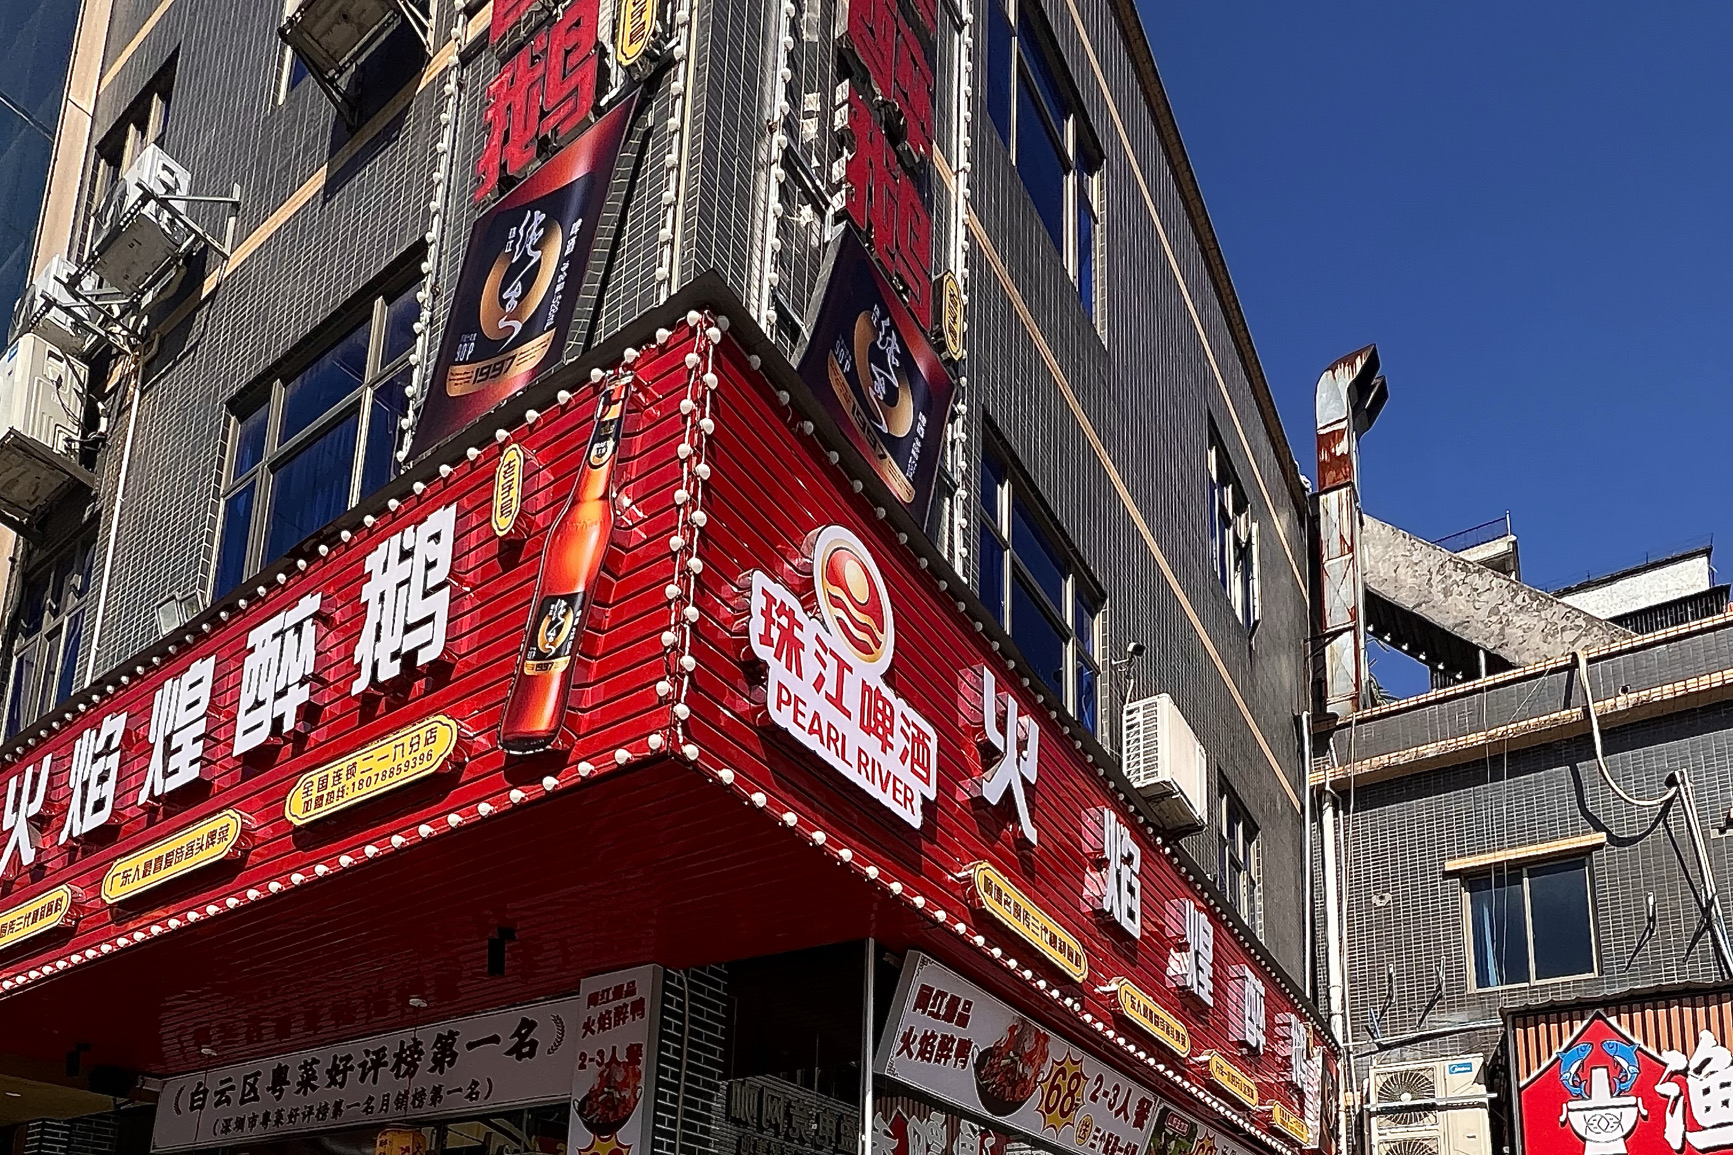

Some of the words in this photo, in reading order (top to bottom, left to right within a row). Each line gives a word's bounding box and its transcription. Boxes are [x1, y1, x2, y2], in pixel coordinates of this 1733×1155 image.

[628, 0, 647, 48] 字号
[473, 0, 599, 204] 鹅
[472, 353, 517, 385] 1997
[499, 459, 521, 520] 老字号
[0, 503, 457, 877] 火焰煌醉鹅
[758, 586, 932, 790] 珠江啤酒
[776, 680, 853, 769] PEARL
[857, 745, 917, 816] RIVER
[188, 1016, 540, 1113] 白云区粤菜好评榜第一名
